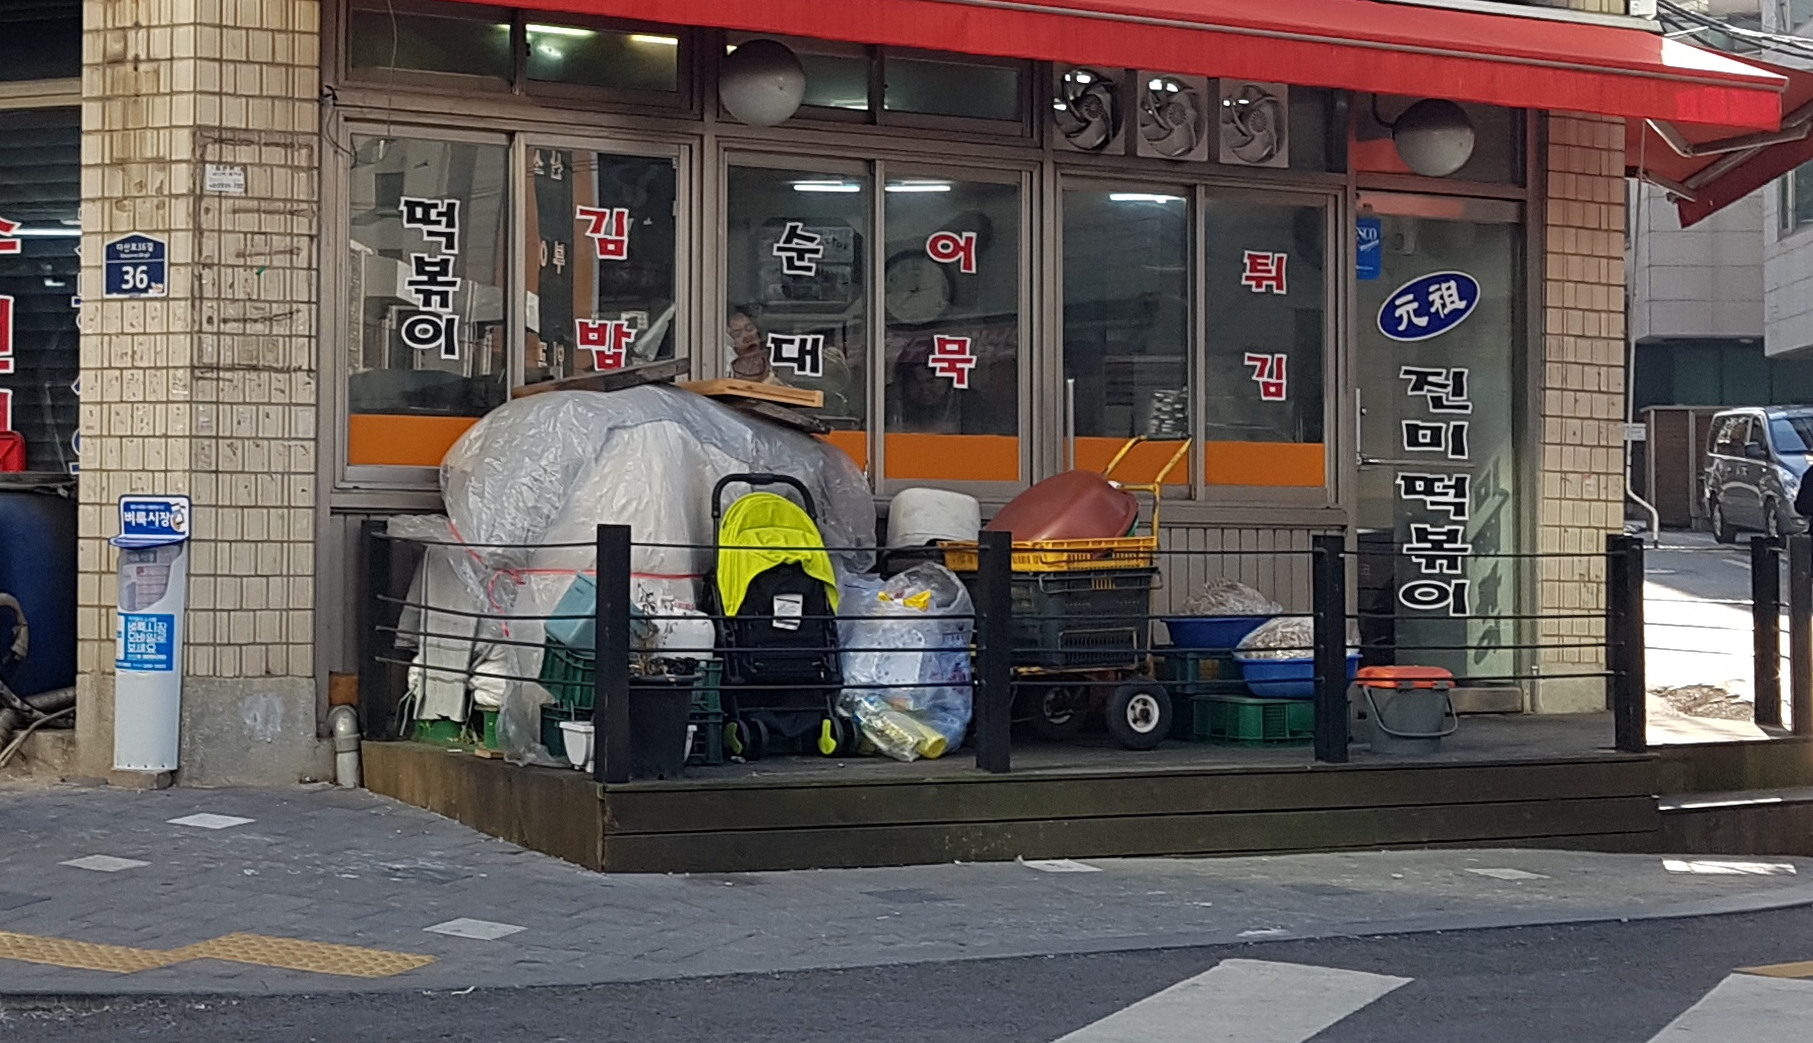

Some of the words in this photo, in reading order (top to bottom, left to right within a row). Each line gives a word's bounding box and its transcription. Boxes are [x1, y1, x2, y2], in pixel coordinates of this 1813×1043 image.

[121, 265, 149, 290] 36
[1395, 280, 1468, 331] 元祖
[124, 511, 171, 528] 벼룩시장
